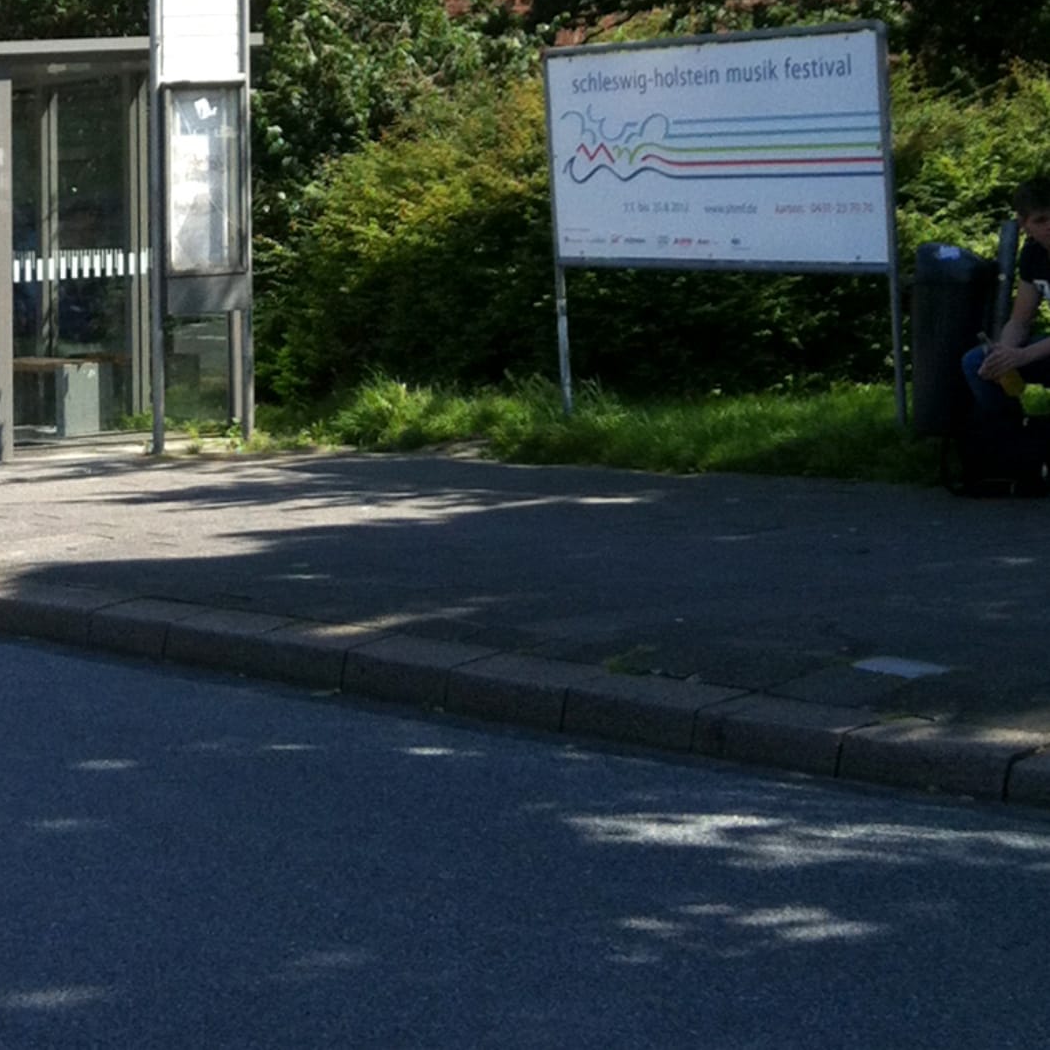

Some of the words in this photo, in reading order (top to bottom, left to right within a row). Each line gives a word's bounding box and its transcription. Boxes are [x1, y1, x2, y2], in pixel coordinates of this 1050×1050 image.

[571, 67, 720, 96] schleswig-holstein
[725, 59, 779, 83] musik
[784, 53, 852, 80] festival
